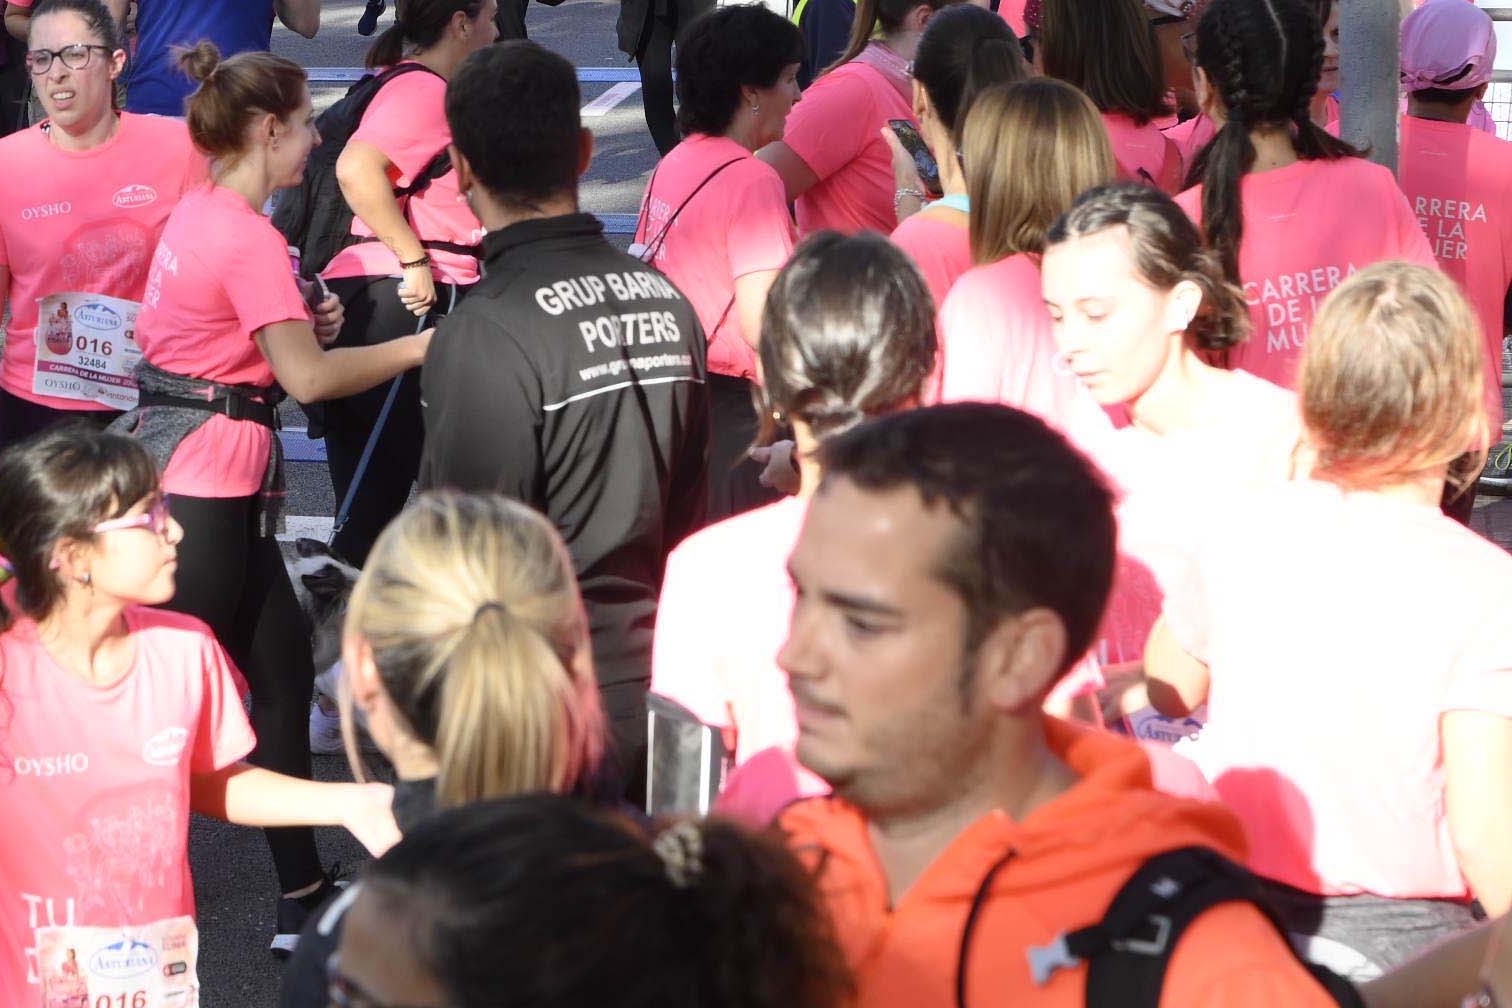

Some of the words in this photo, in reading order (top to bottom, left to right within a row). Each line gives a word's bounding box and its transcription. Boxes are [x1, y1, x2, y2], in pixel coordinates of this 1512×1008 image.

[21, 201, 72, 220] OYSHO
[1415, 196, 1488, 223] RRERA
[1438, 218, 1465, 239] LA
[535, 275, 605, 316] GRUP
[605, 271, 681, 301] BARNA
[79, 311, 118, 326] ASTURIANA
[1267, 301, 1300, 328] DE
[579, 311, 680, 353] PORTERS
[76, 335, 113, 356] 016
[78, 356, 107, 369] 32484
[44, 378, 81, 391] OYSHO
[14, 752, 88, 775] OYSHO
[22, 893, 75, 929] TU
